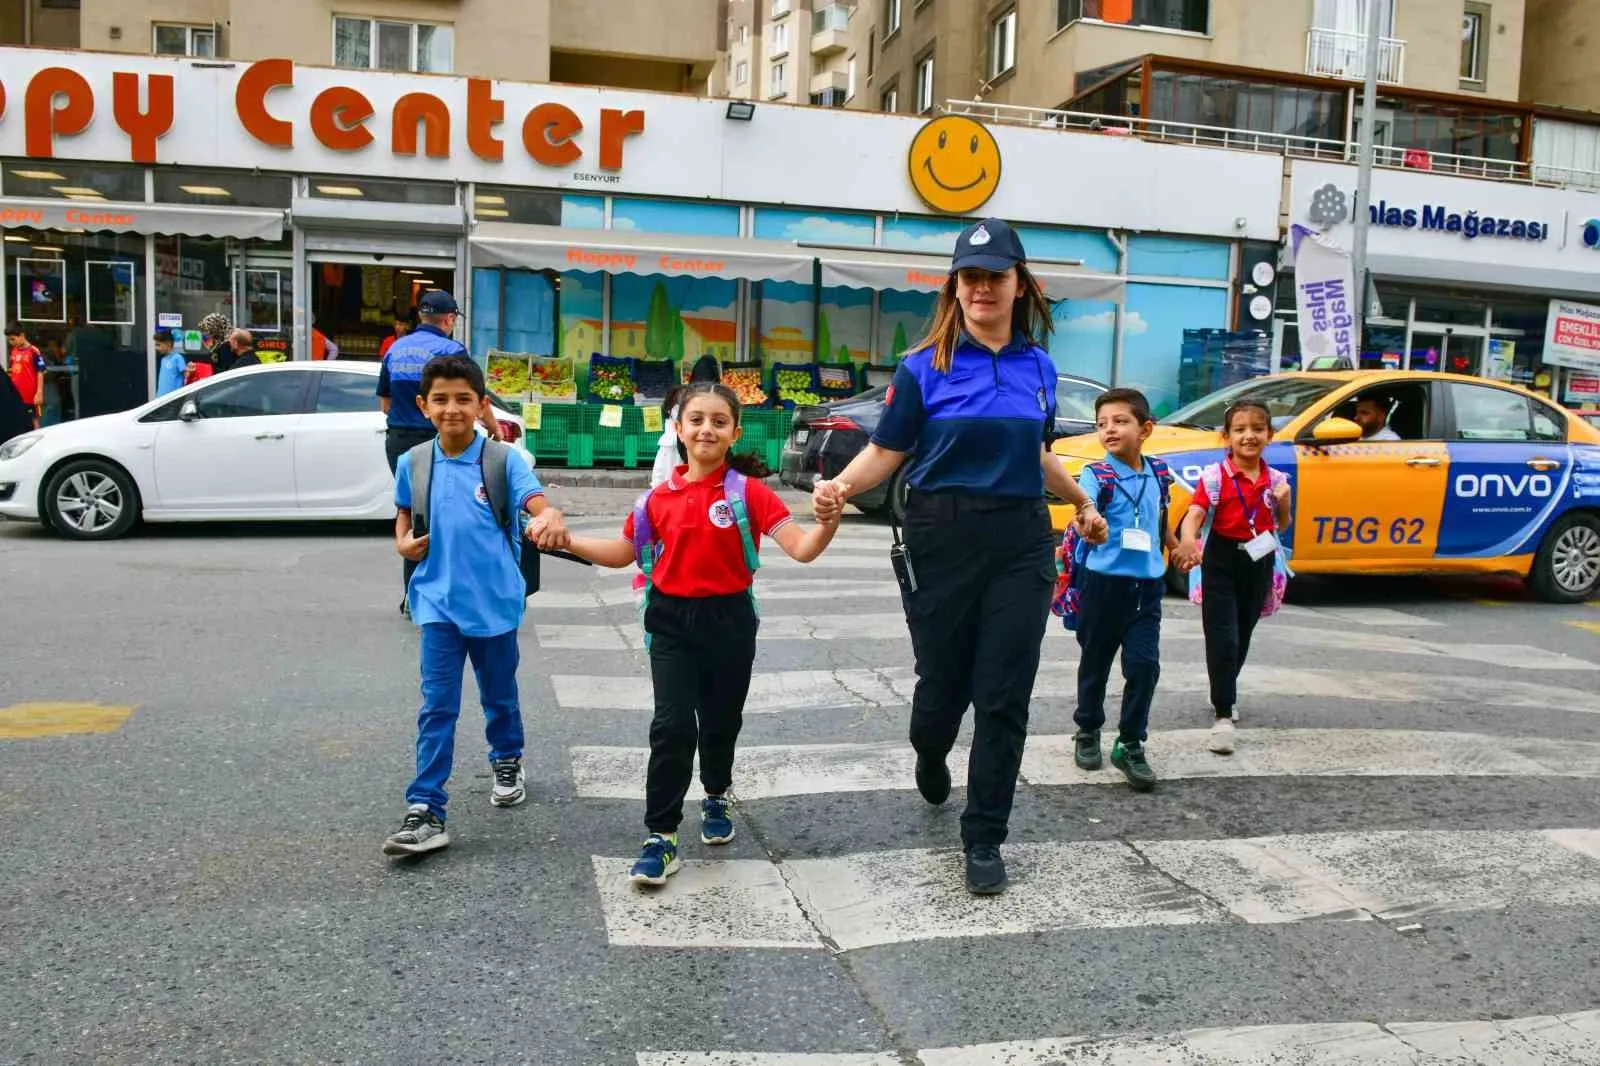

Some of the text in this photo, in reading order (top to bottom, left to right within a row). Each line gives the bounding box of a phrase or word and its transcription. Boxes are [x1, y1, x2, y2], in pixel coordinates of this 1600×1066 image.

[0, 58, 645, 170] py Center
[574, 172, 620, 184] ESENYURT
[65, 208, 136, 225] Center
[1352, 189, 1548, 239] las Mağazası
[566, 248, 727, 272] Happy Center
[1312, 516, 1425, 545] TBG 62
